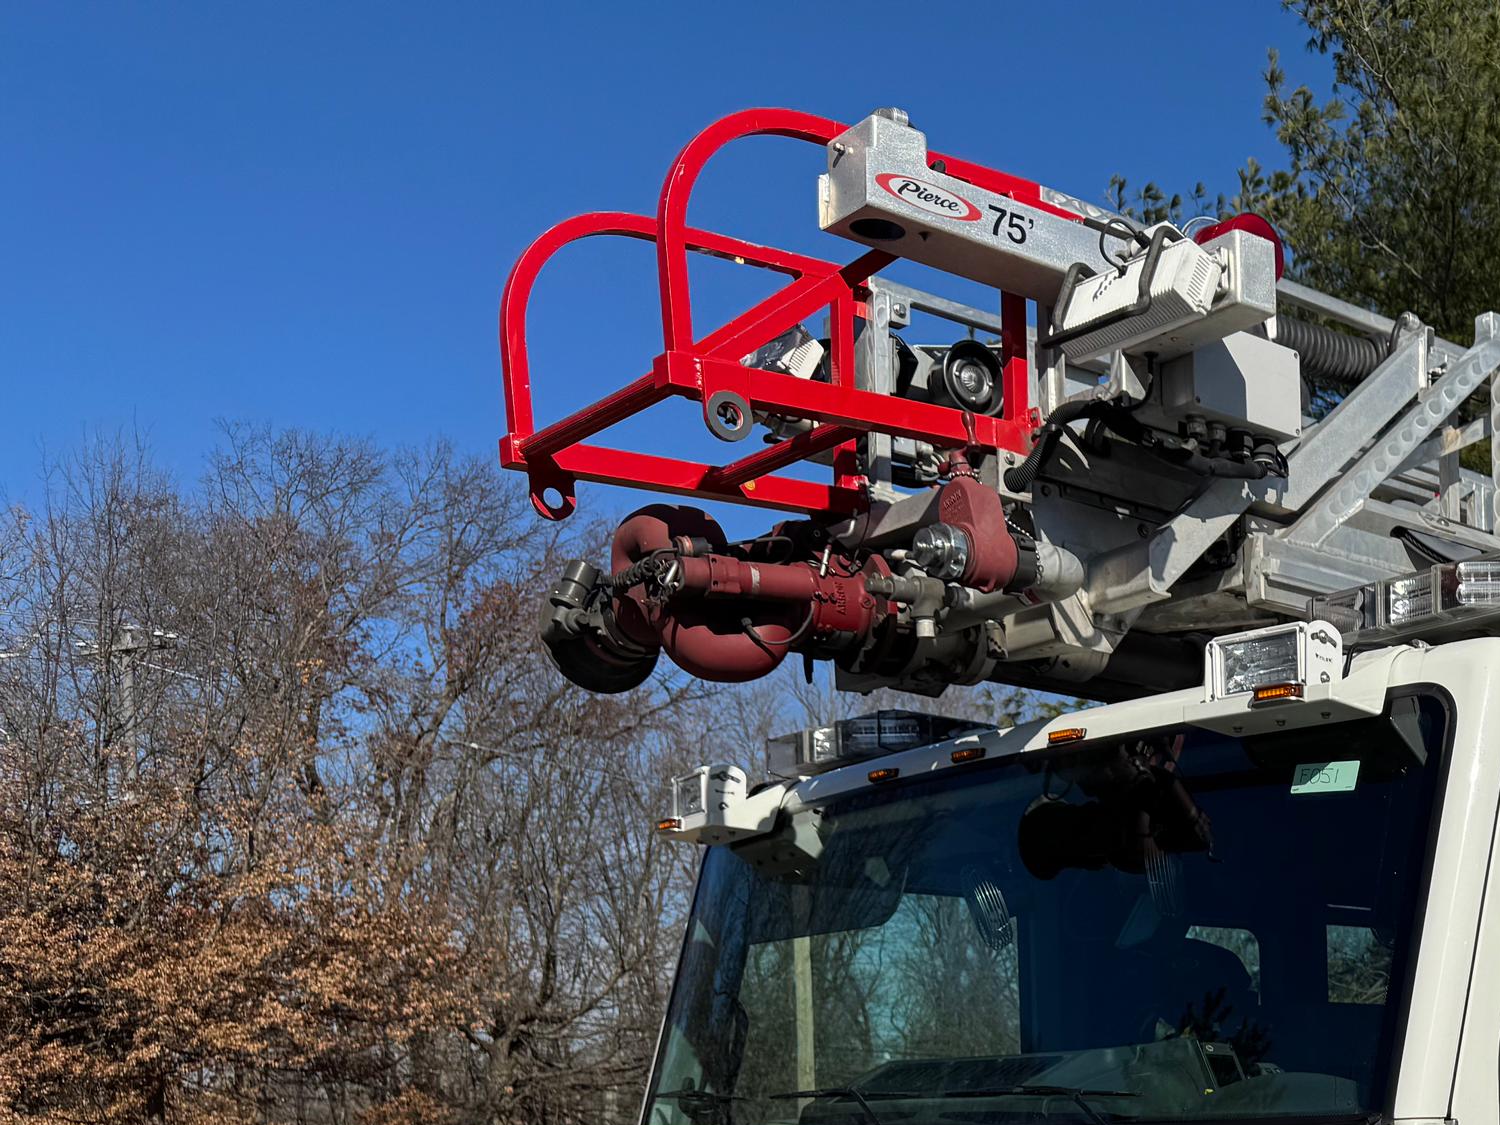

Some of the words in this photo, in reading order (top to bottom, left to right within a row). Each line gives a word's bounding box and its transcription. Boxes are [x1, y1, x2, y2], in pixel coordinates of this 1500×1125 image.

[897, 179, 961, 212] Pierce
[988, 204, 1034, 245] 75'
[1300, 767, 1339, 784] F051
